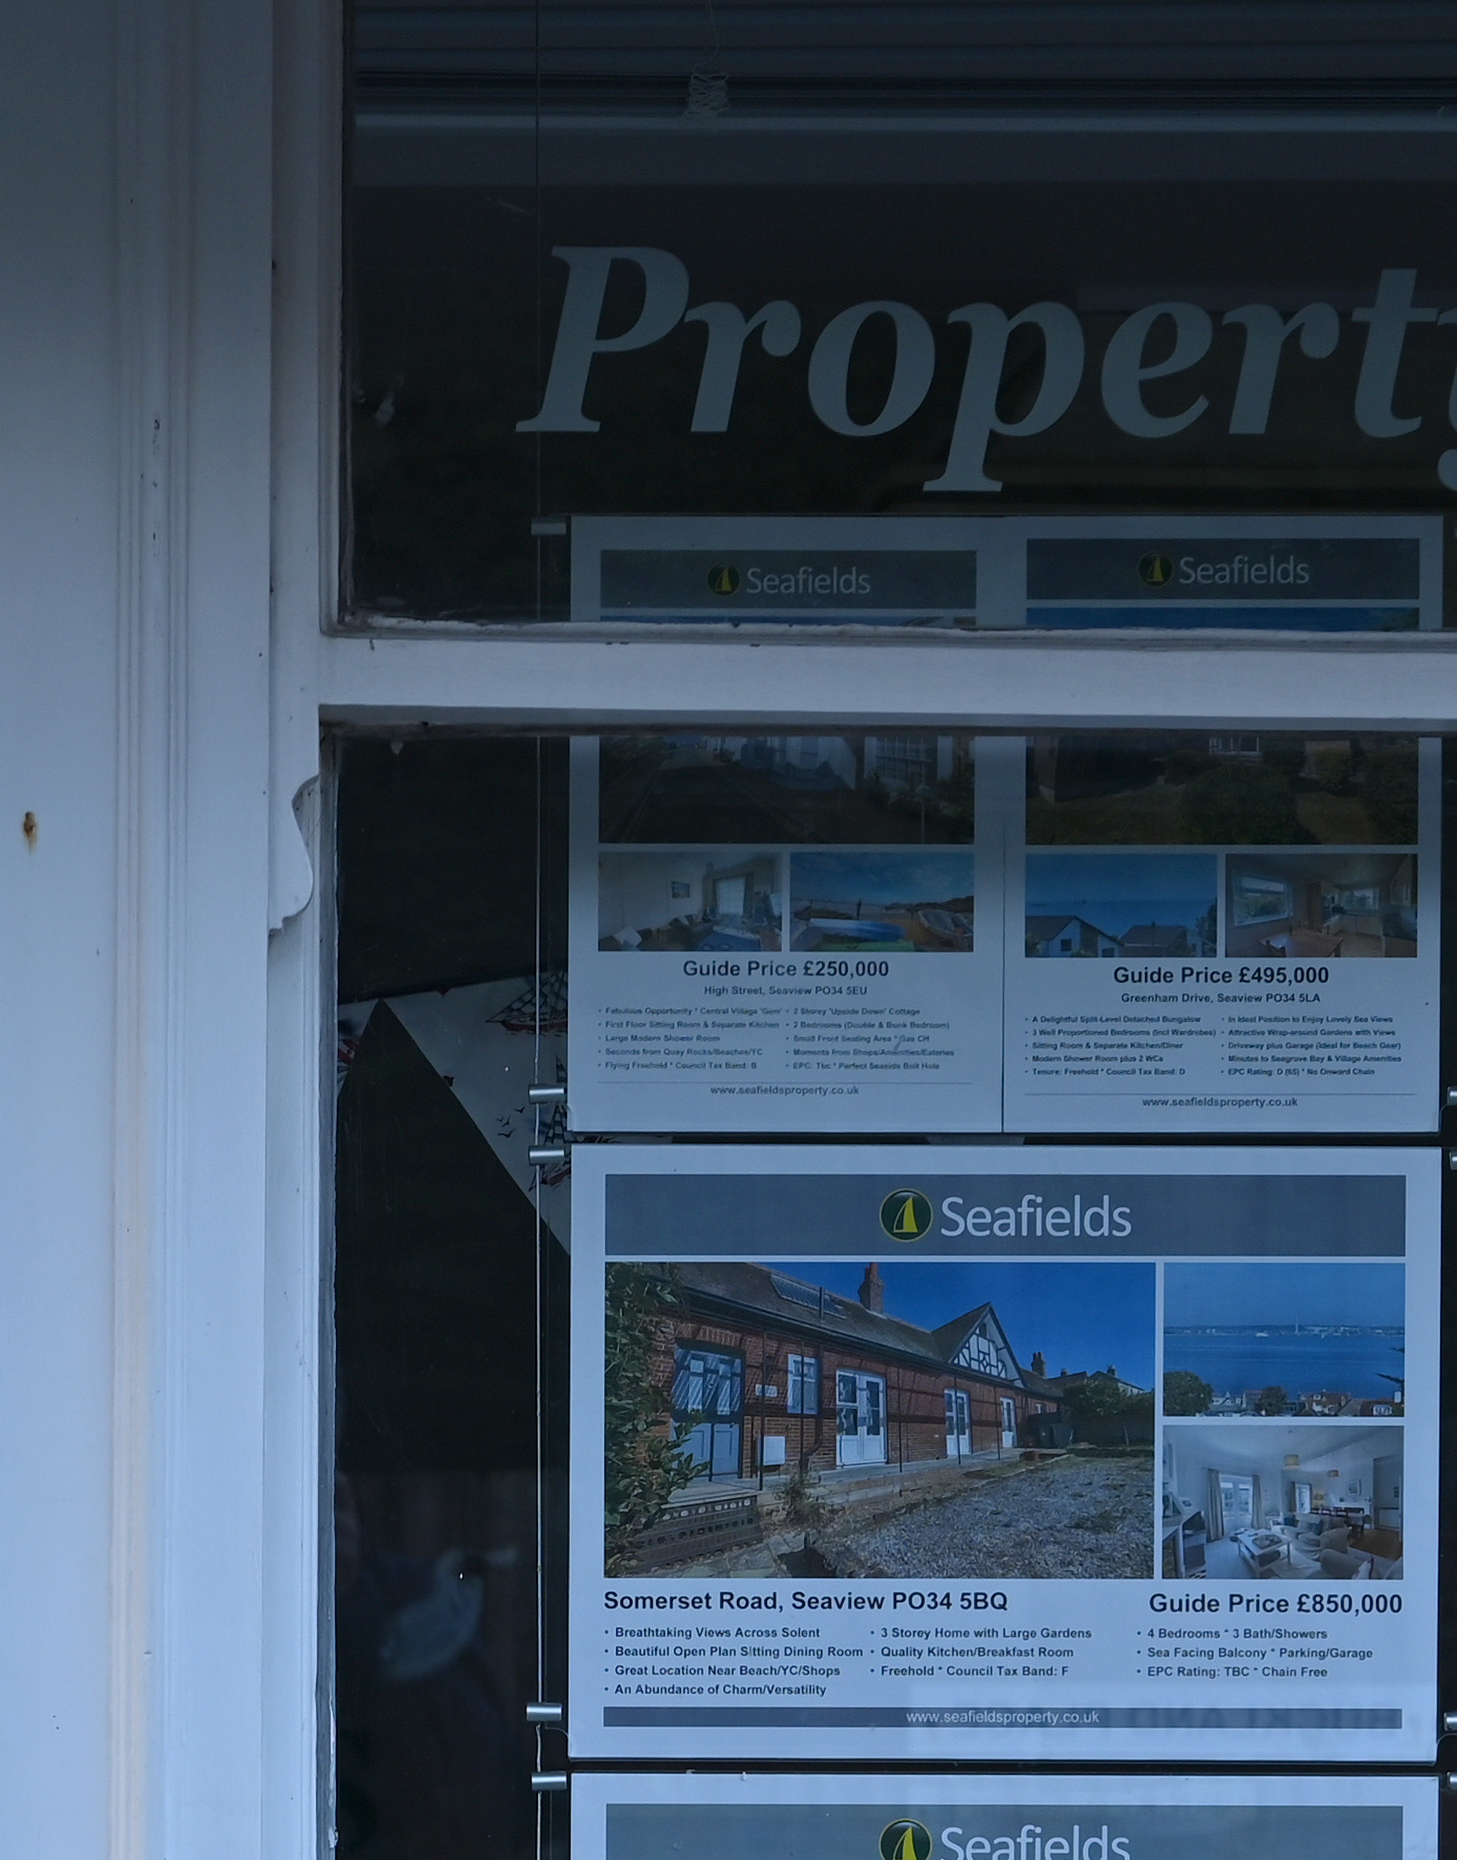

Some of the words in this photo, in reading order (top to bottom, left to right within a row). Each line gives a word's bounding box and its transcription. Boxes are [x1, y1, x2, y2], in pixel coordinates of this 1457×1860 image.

[1178, 554, 1310, 585] Seafields
[745, 565, 871, 594] Seafields
[682, 959, 741, 977] Guide
[747, 960, 797, 977] Price
[802, 960, 889, 980] £250,000
[1113, 966, 1174, 984] Guide
[1181, 966, 1233, 984] Price
[1238, 966, 1329, 987] £495,000
[703, 985, 729, 997] High
[731, 985, 766, 996] Street,
[768, 985, 812, 995] Seaview
[814, 985, 843, 996] PO34
[845, 985, 868, 996] 5EU
[1120, 992, 1179, 1003] Greenham
[1181, 992, 1214, 1004] Drive,
[1216, 992, 1263, 1003] Seaview
[1265, 992, 1296, 1003] PO34
[1298, 992, 1321, 1003] 5LA
[709, 1081, 859, 1097] www.seafieldsproperty.co.uk
[1137, 1093, 1303, 1109] www.seafieldsproperty.co.uk
[940, 1193, 1132, 1237] Seafields
[603, 1590, 712, 1610] Somerset
[719, 1590, 784, 1613] Road,
[791, 1591, 885, 1610] Seaview
[892, 1591, 953, 1610] PO34
[959, 1591, 1008, 1611] 5BQ
[1148, 1592, 1220, 1613] Guide
[1228, 1593, 1289, 1613] Price
[1296, 1593, 1402, 1617] £850,000
[614, 1626, 692, 1640] Breathtaking
[695, 1626, 732, 1638] Views
[734, 1626, 778, 1638] Across
[781, 1626, 820, 1638] Solent
[880, 1645, 924, 1660] Quality
[926, 1646, 1035, 1658] Kitchen/Breakfast
[1037, 1646, 1074, 1658] Room
[905, 1709, 1100, 1726] www.seafieldsproperty.co.uk
